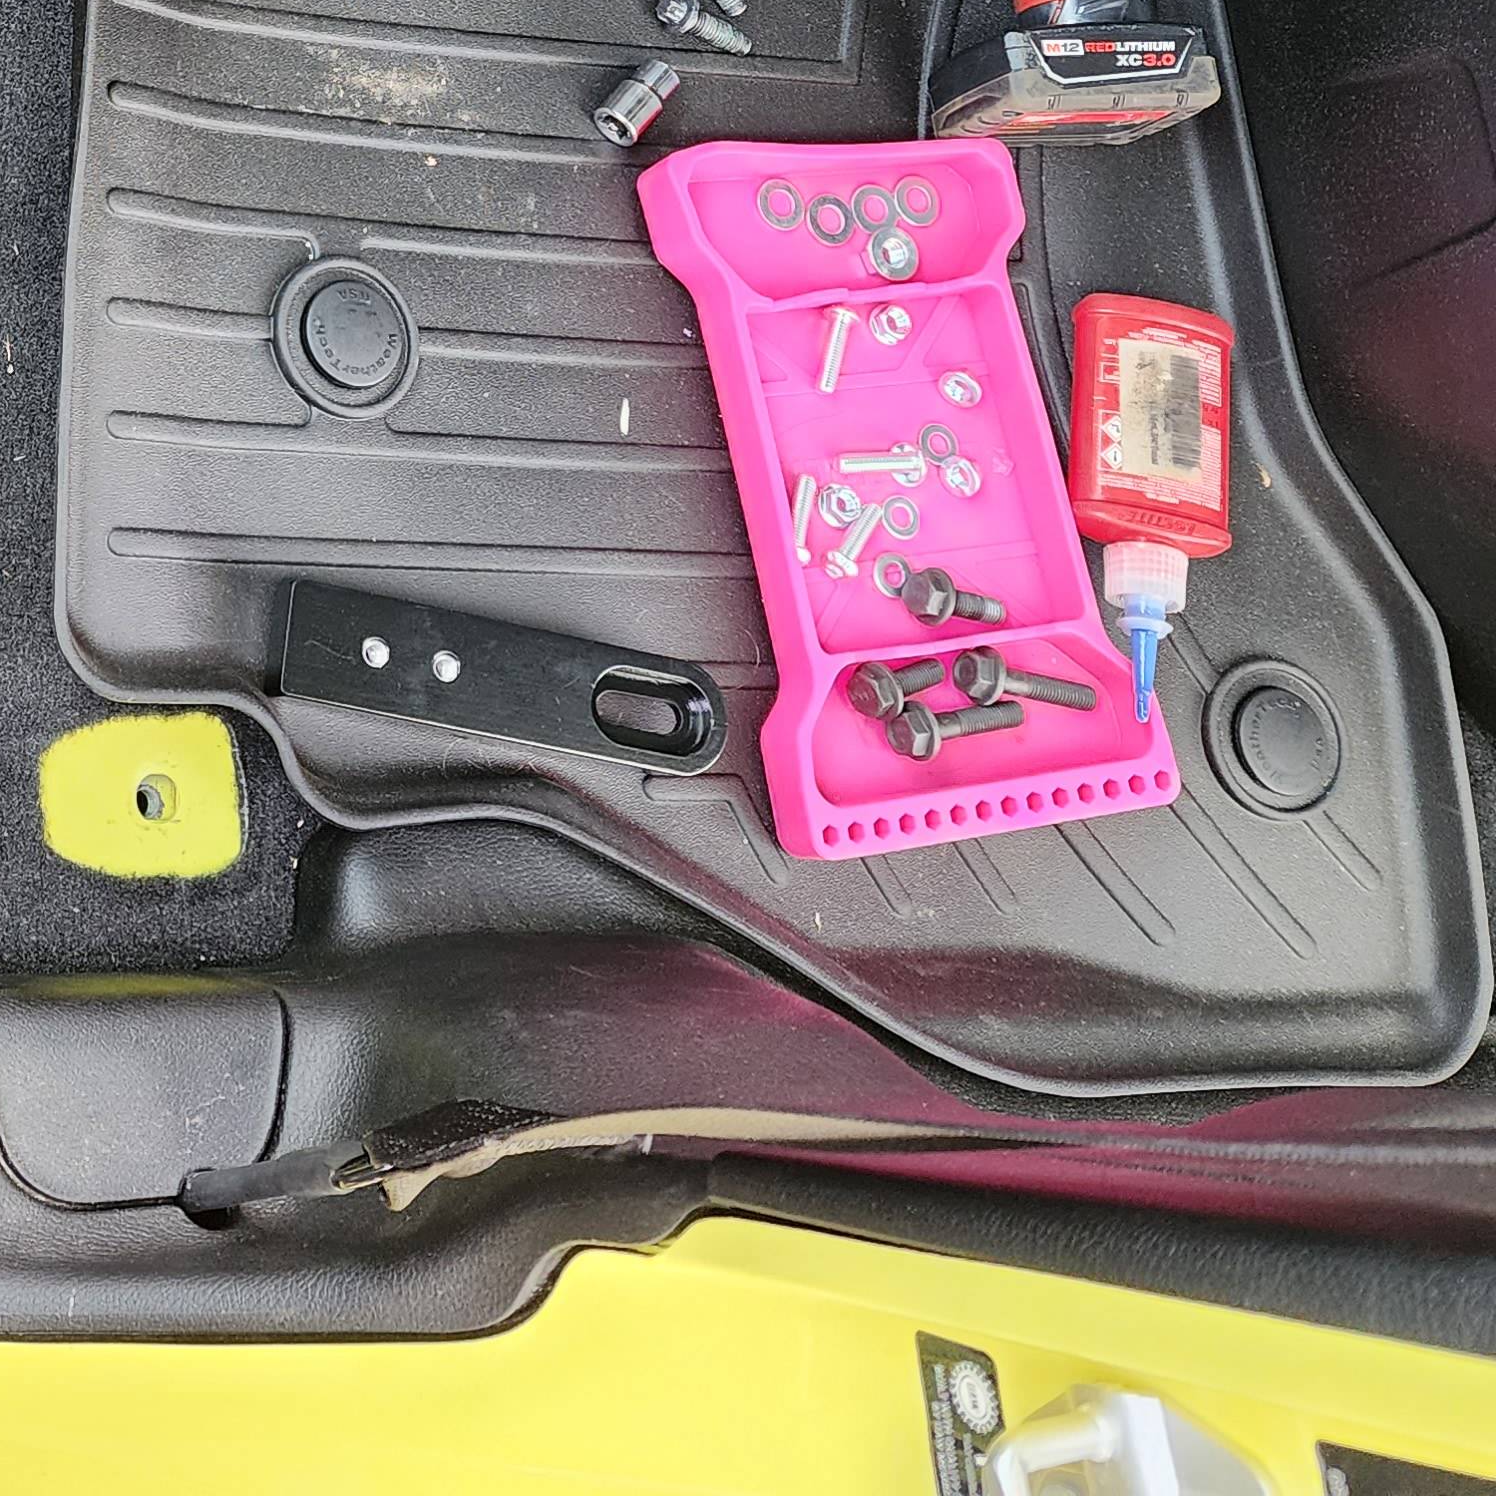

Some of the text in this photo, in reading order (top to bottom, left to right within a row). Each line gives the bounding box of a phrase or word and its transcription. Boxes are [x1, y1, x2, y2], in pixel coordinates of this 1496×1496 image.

[1046, 40, 1176, 53] M12 REDLITHIUM
[1114, 53, 1177, 67] XC3.0
[315, 324, 399, 376] WeatherTech
